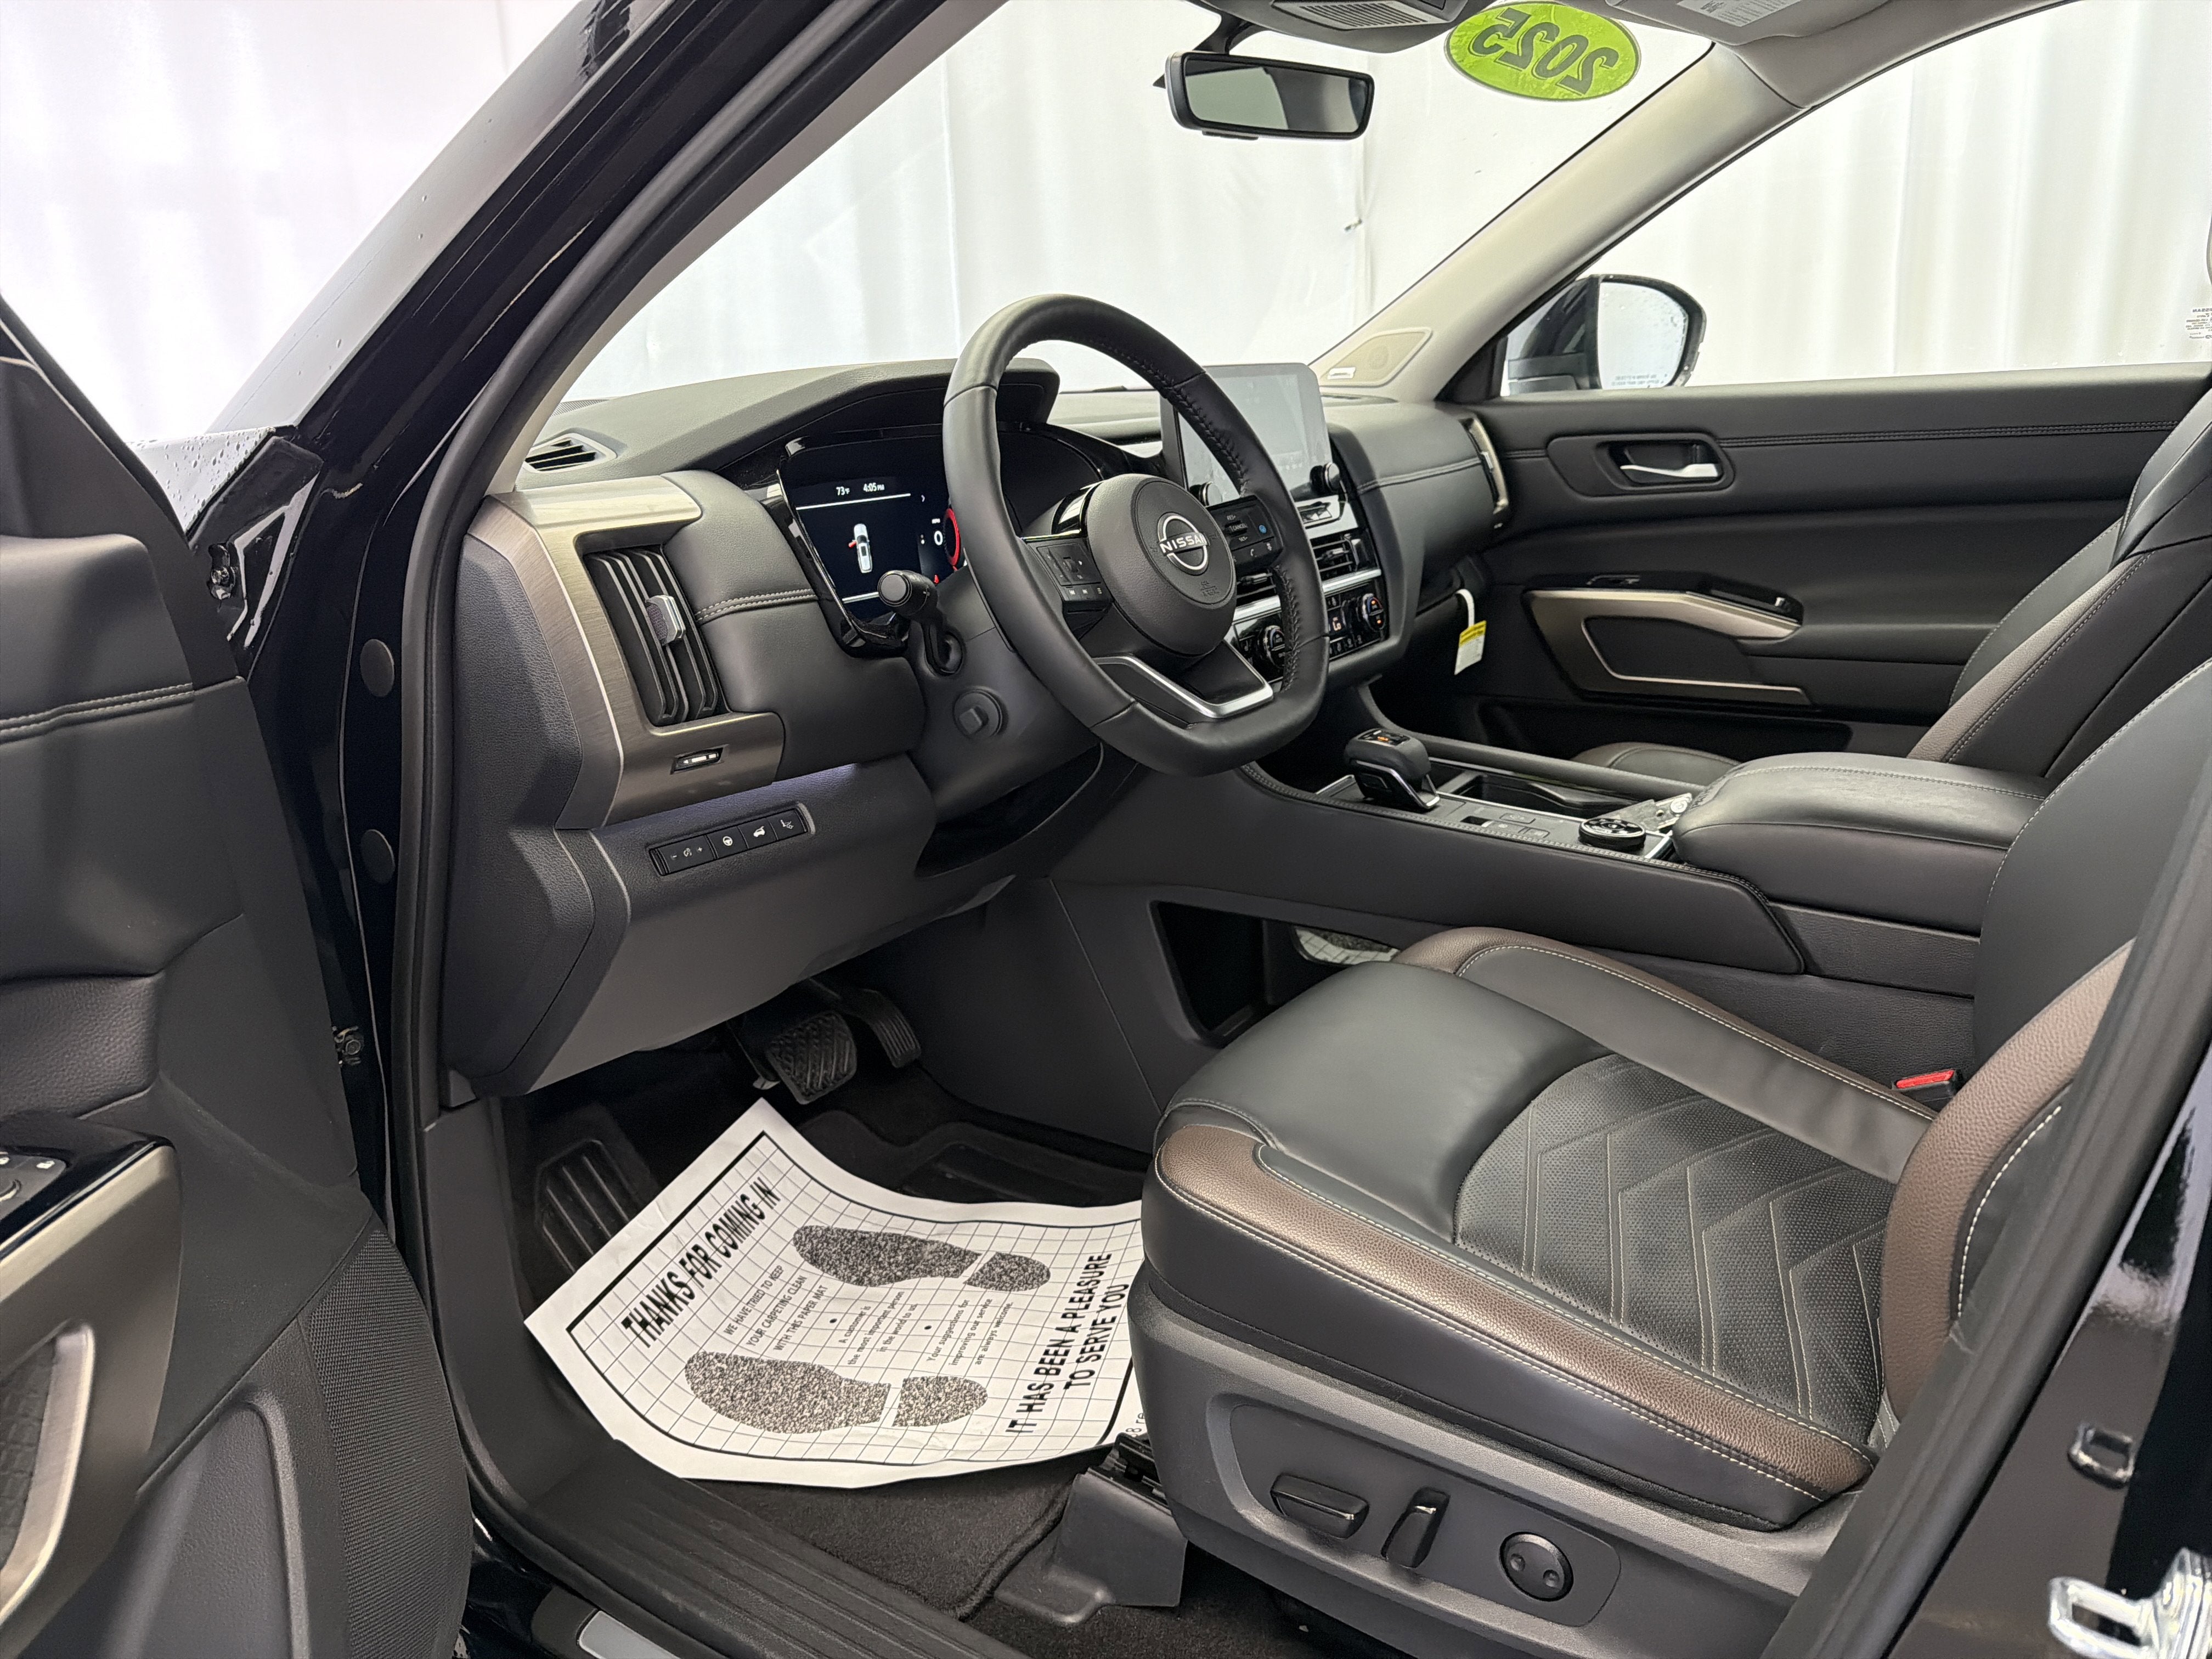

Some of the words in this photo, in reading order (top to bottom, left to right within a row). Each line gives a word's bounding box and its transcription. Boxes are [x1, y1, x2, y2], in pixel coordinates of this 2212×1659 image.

[934, 531, 943, 546] 0
[1160, 534, 1207, 553] NISSAN
[621, 1271, 695, 1348] THANKS
[679, 1244, 722, 1288] FOR
[705, 1194, 765, 1258] COMING
[749, 1177, 781, 1209] IN
[723, 1323, 738, 1335] WE
[733, 1306, 752, 1325] HAVE
[747, 1289, 765, 1307] TRIED
[761, 1280, 773, 1290] TO
[769, 1265, 784, 1281] KEEP
[1060, 1253, 1113, 1319] PLEASURE
[1096, 1284, 1130, 1313] YOU
[746, 1328, 766, 1346] YOUR
[761, 1295, 792, 1328] CARPETING
[787, 1275, 807, 1295] CLEAN
[773, 1334, 792, 1351] WITH
[786, 1319, 803, 1334] THIS
[797, 1300, 818, 1319] PAPER
[812, 1285, 828, 1301] MAT
[844, 1311, 867, 1337] customer
[848, 1354, 860, 1365] the
[856, 1336, 872, 1352] most
[864, 1310, 891, 1335] important
[887, 1291, 905, 1309] person
[883, 1335, 895, 1345] the
[891, 1318, 907, 1335] world
[926, 1346, 942, 1362] Your
[939, 1310, 964, 1345] suggestions
[958, 1300, 970, 1308] for
[1054, 1324, 1082, 1333] A
[948, 1332, 975, 1365] improving
[970, 1320, 980, 1331] our
[977, 1299, 992, 1319] service
[975, 1354, 985, 1365] are
[980, 1330, 997, 1352] always
[994, 1302, 1014, 1328] welcome.
[1076, 1316, 1118, 1363] SERVE
[1033, 1339, 1075, 1376] BEEN
[1015, 1383, 1054, 1413] HAS
[1063, 1369, 1096, 1390] TO
[1005, 1419, 1037, 1433] IT
